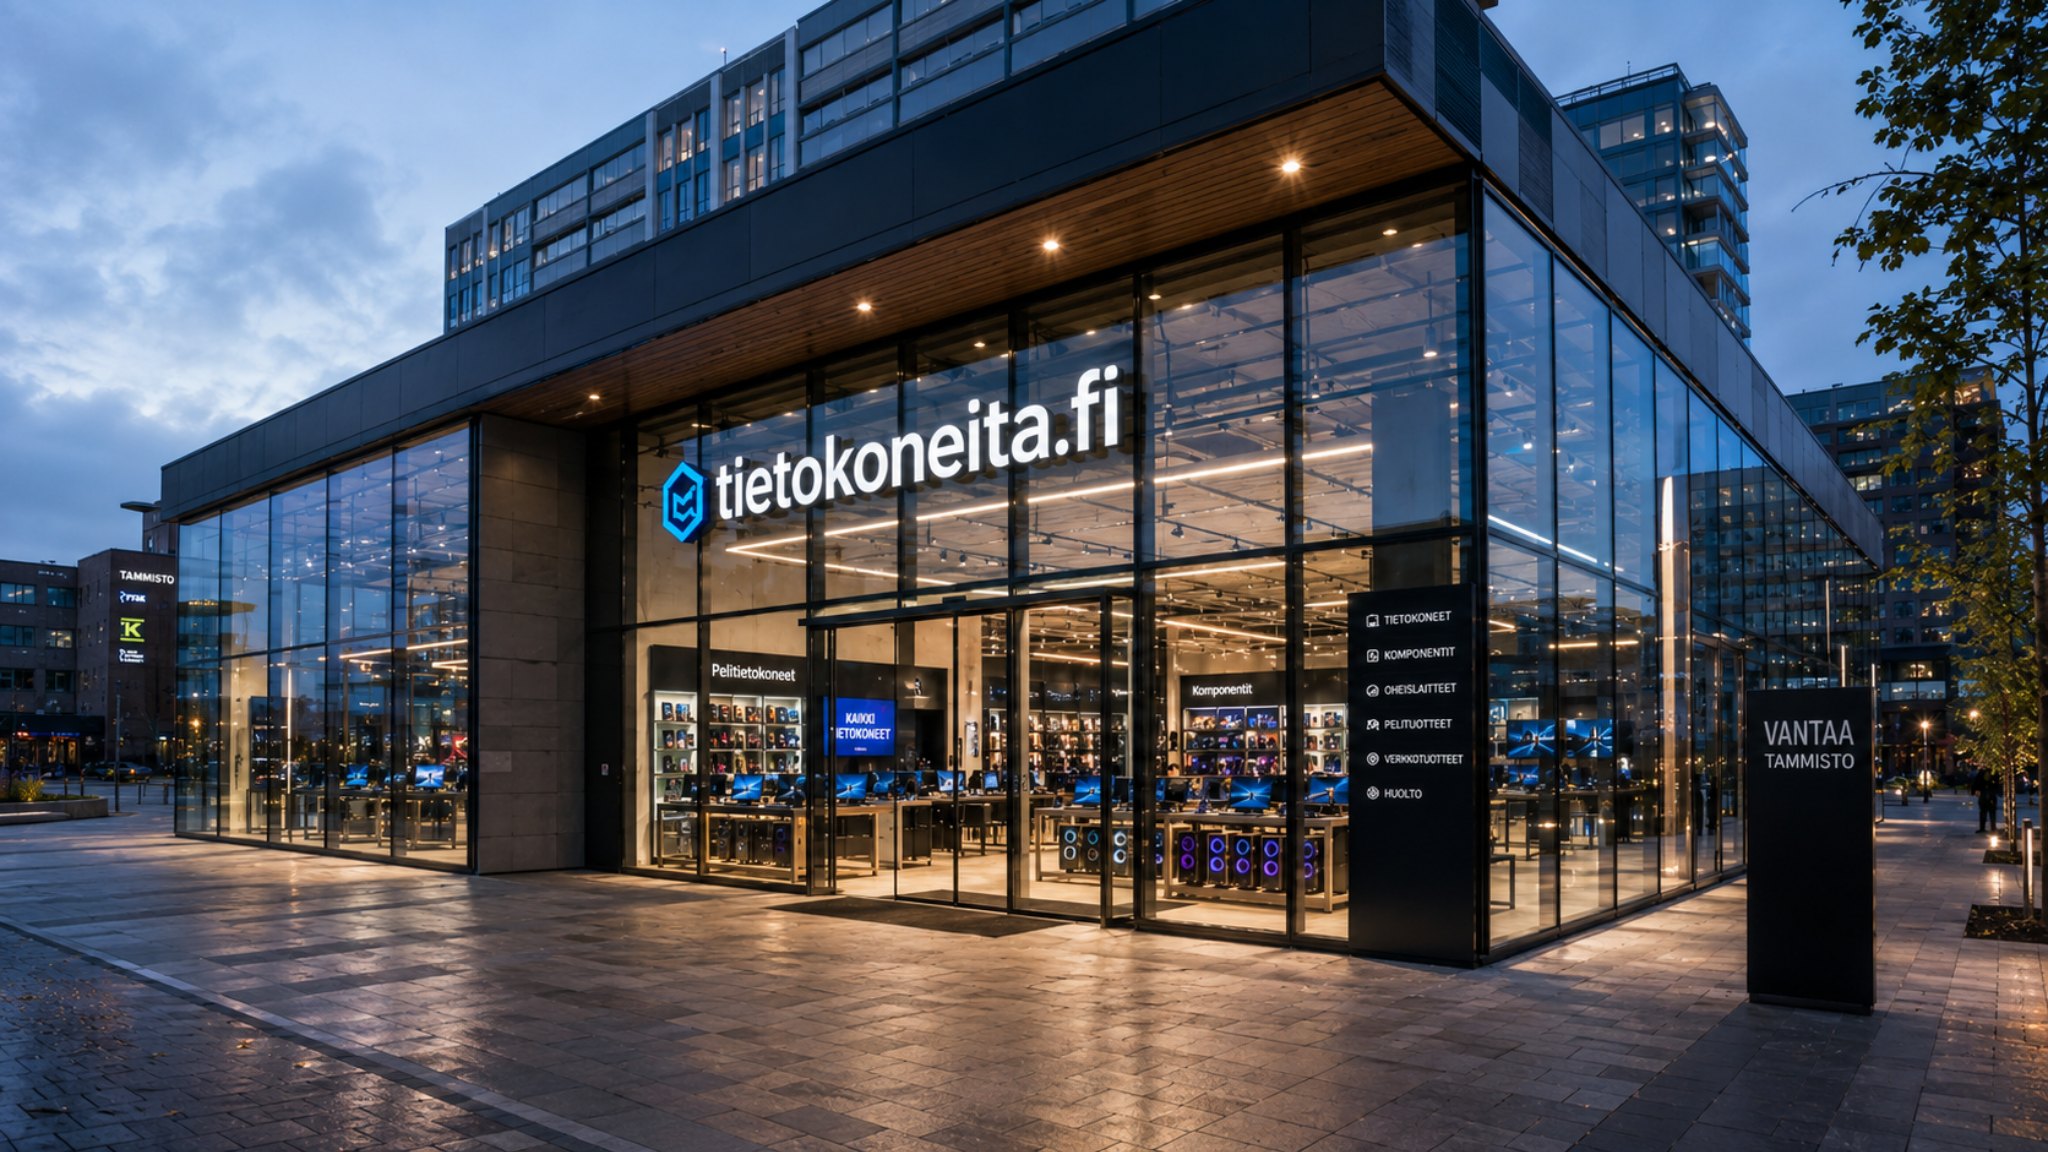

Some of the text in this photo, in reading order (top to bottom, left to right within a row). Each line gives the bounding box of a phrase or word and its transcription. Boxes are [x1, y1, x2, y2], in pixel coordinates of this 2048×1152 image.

[716, 364, 1120, 520] tietokoneita.fi
[119, 570, 175, 585] TAMMISTO
[1384, 610, 1452, 625] TIETOKONEET
[1384, 646, 1456, 660] KOMPONENTIT
[712, 663, 796, 682] Pelitietokoneet
[1192, 682, 1253, 698] Komponentit
[1384, 682, 1457, 695] OHEISLAITTEET
[1384, 718, 1453, 730] PELITUOTTEET
[836, 727, 891, 740] IETOKONEET
[1763, 720, 1855, 746] VANTAA
[1384, 753, 1464, 765] VERKKOTUOTTEET
[1764, 753, 1855, 770] TAMMISTO
[1384, 788, 1423, 800] HUOLTO
